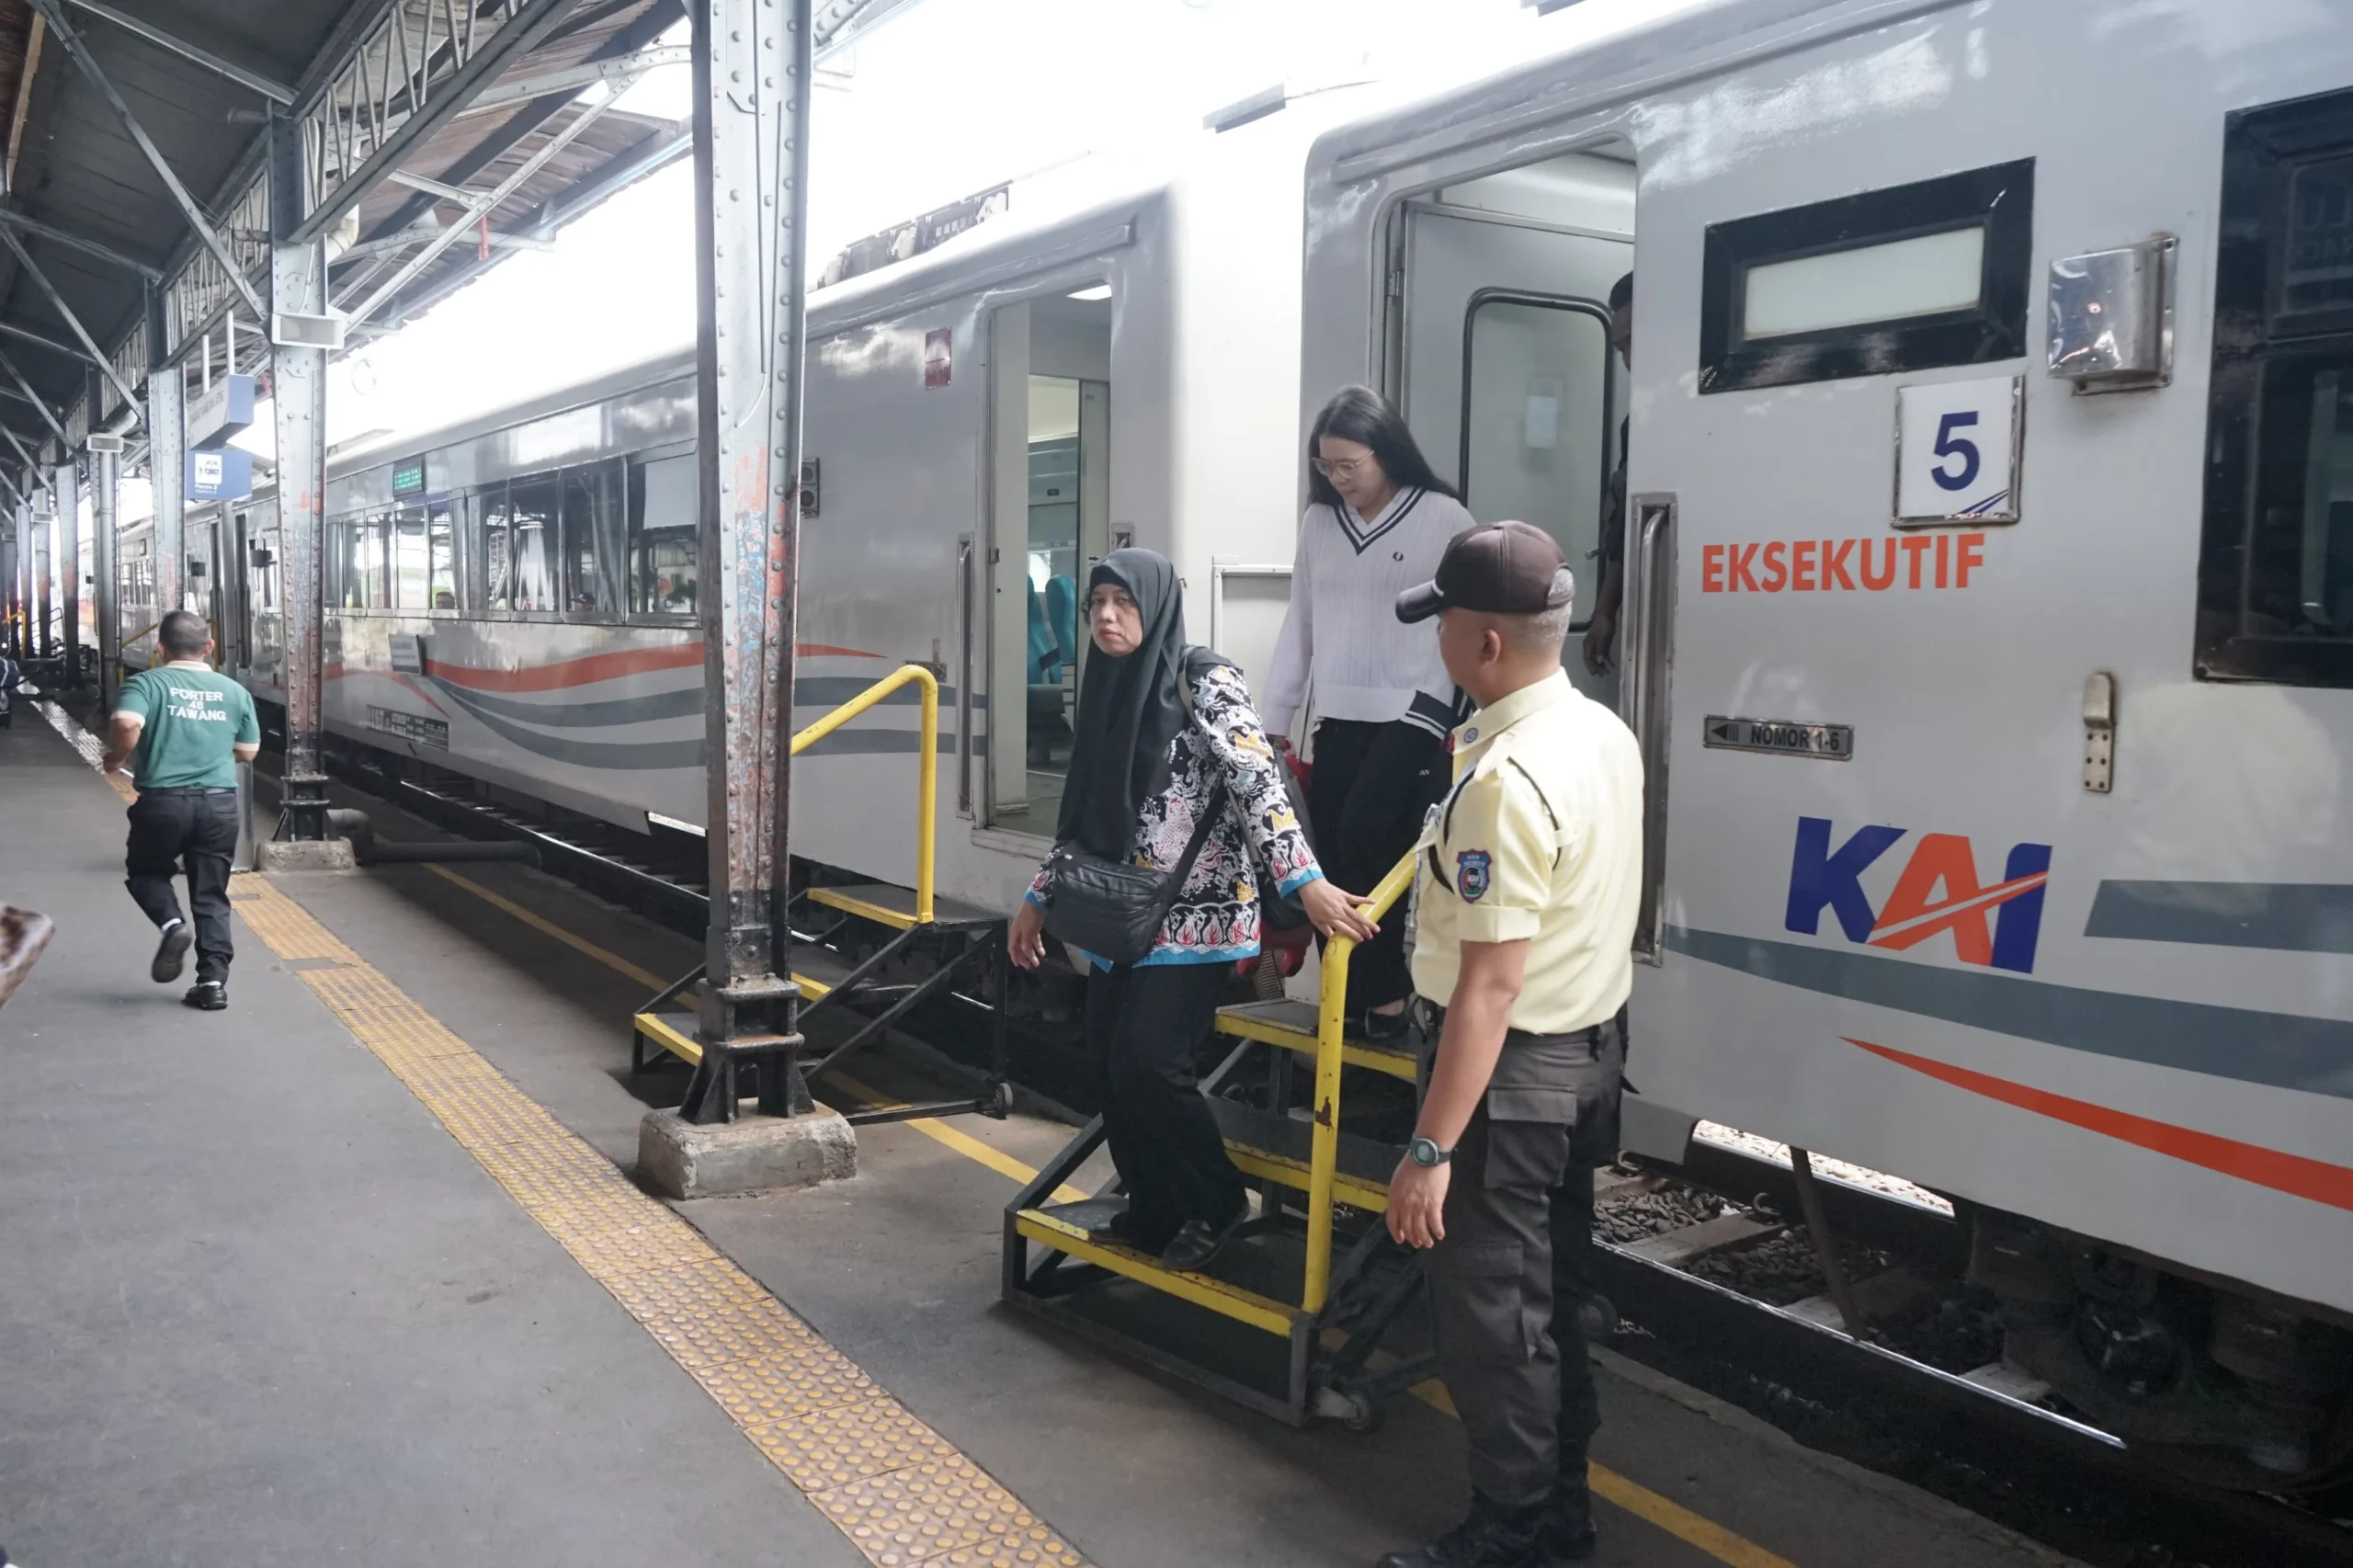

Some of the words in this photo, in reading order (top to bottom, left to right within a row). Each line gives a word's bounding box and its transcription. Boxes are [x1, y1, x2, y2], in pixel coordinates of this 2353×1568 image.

[1930, 410, 1981, 492] 5
[1701, 533, 1985, 593] EKSEKUTIF
[170, 687, 223, 701] PORTER
[188, 700, 204, 710] 48
[166, 704, 227, 722] TAWANG
[1750, 724, 1810, 749] NOMOR
[1785, 815, 2053, 975] KAI
